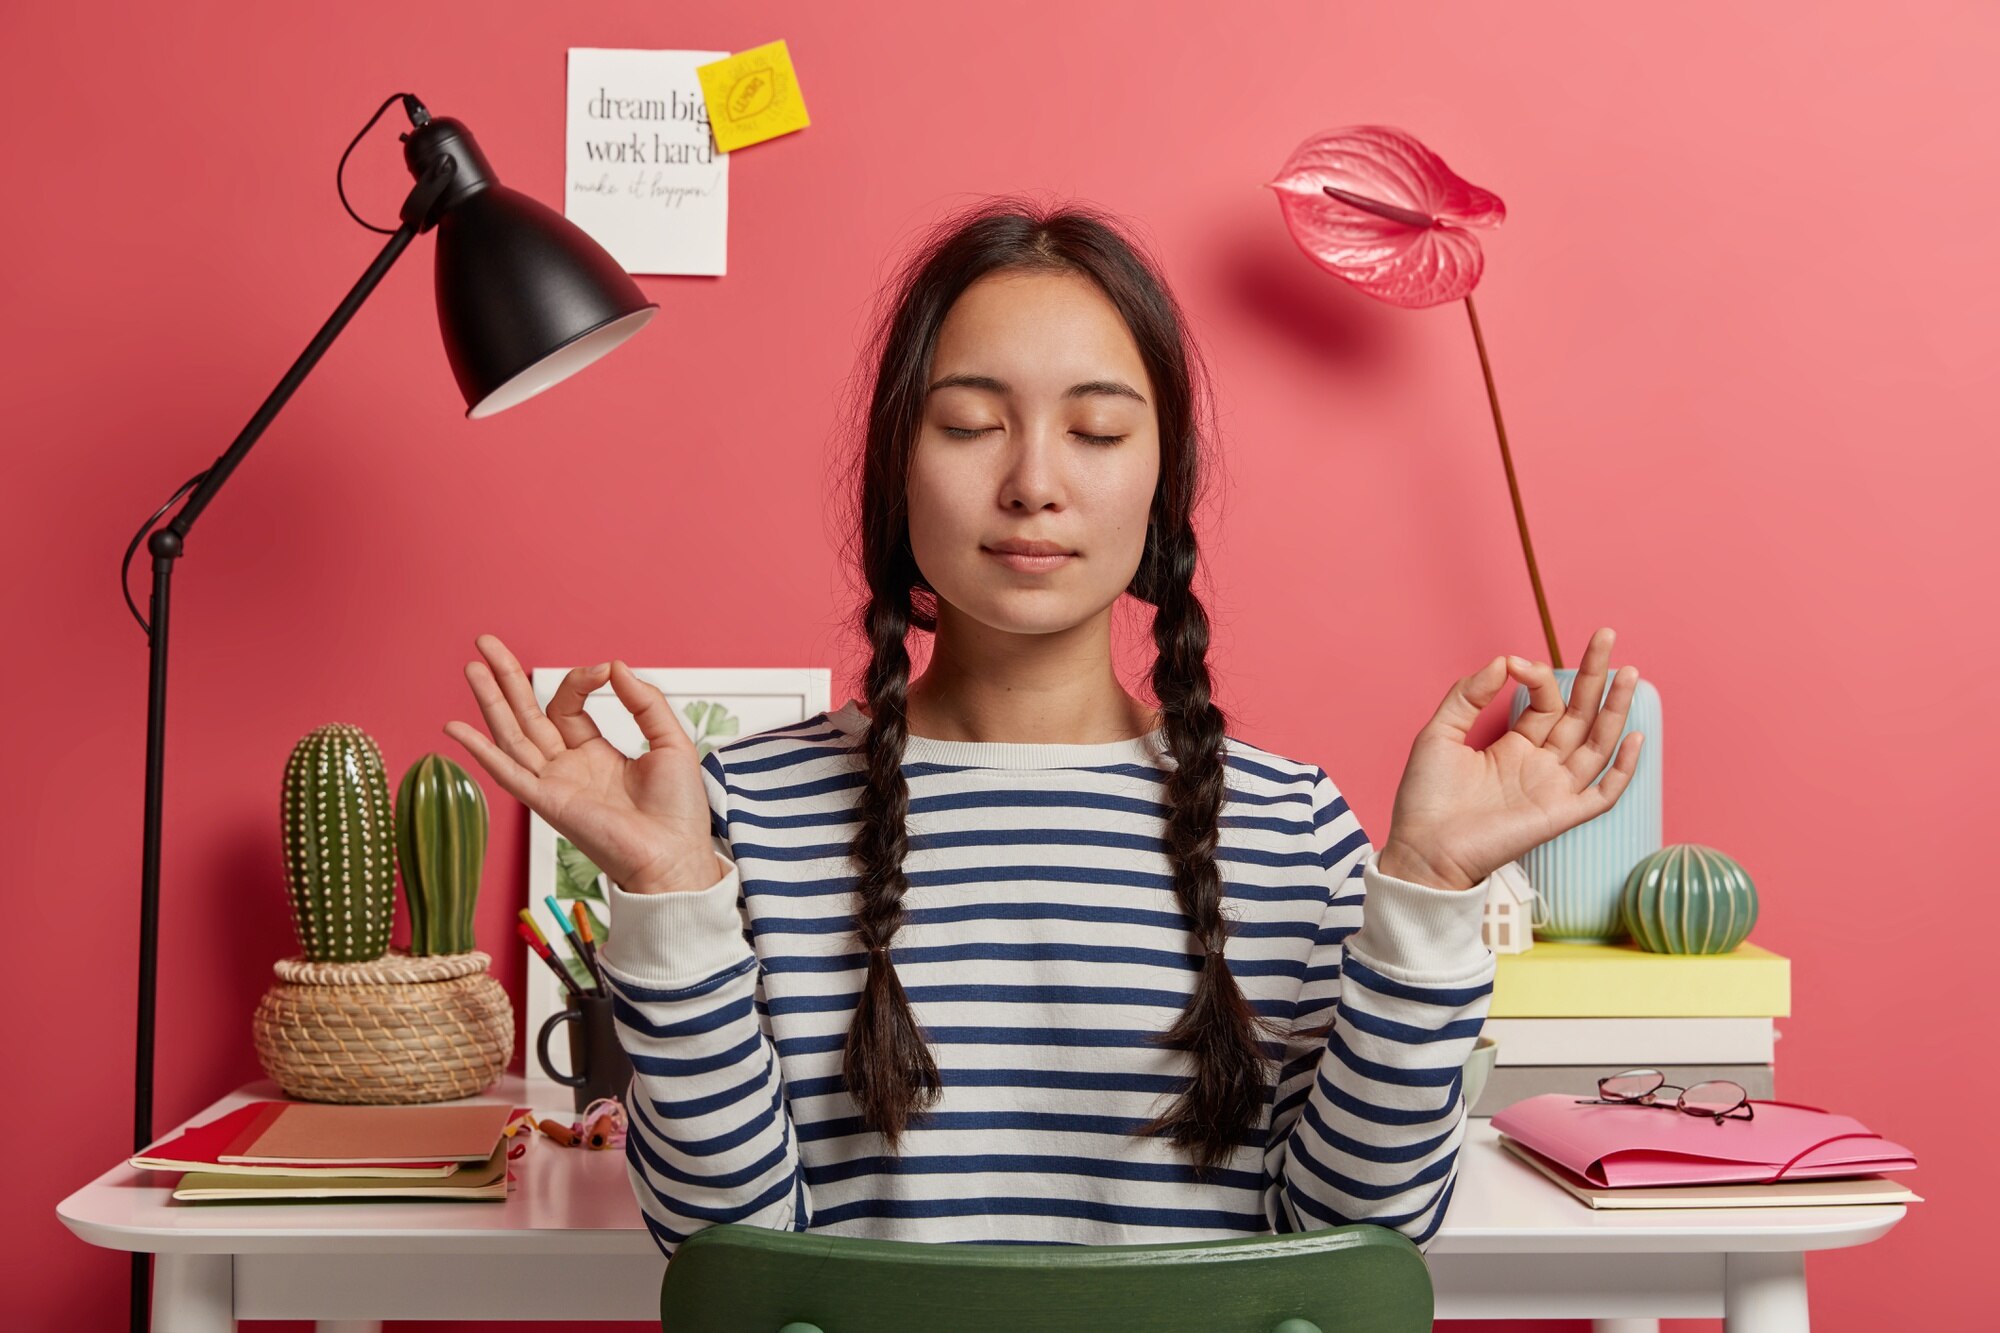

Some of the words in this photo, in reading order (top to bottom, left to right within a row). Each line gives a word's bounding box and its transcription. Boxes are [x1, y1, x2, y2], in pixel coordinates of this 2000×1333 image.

[588, 87, 665, 119] dream
[586, 133, 646, 164] work
[655, 134, 713, 165] hard
[574, 173, 618, 196] make
[629, 170, 646, 199] it
